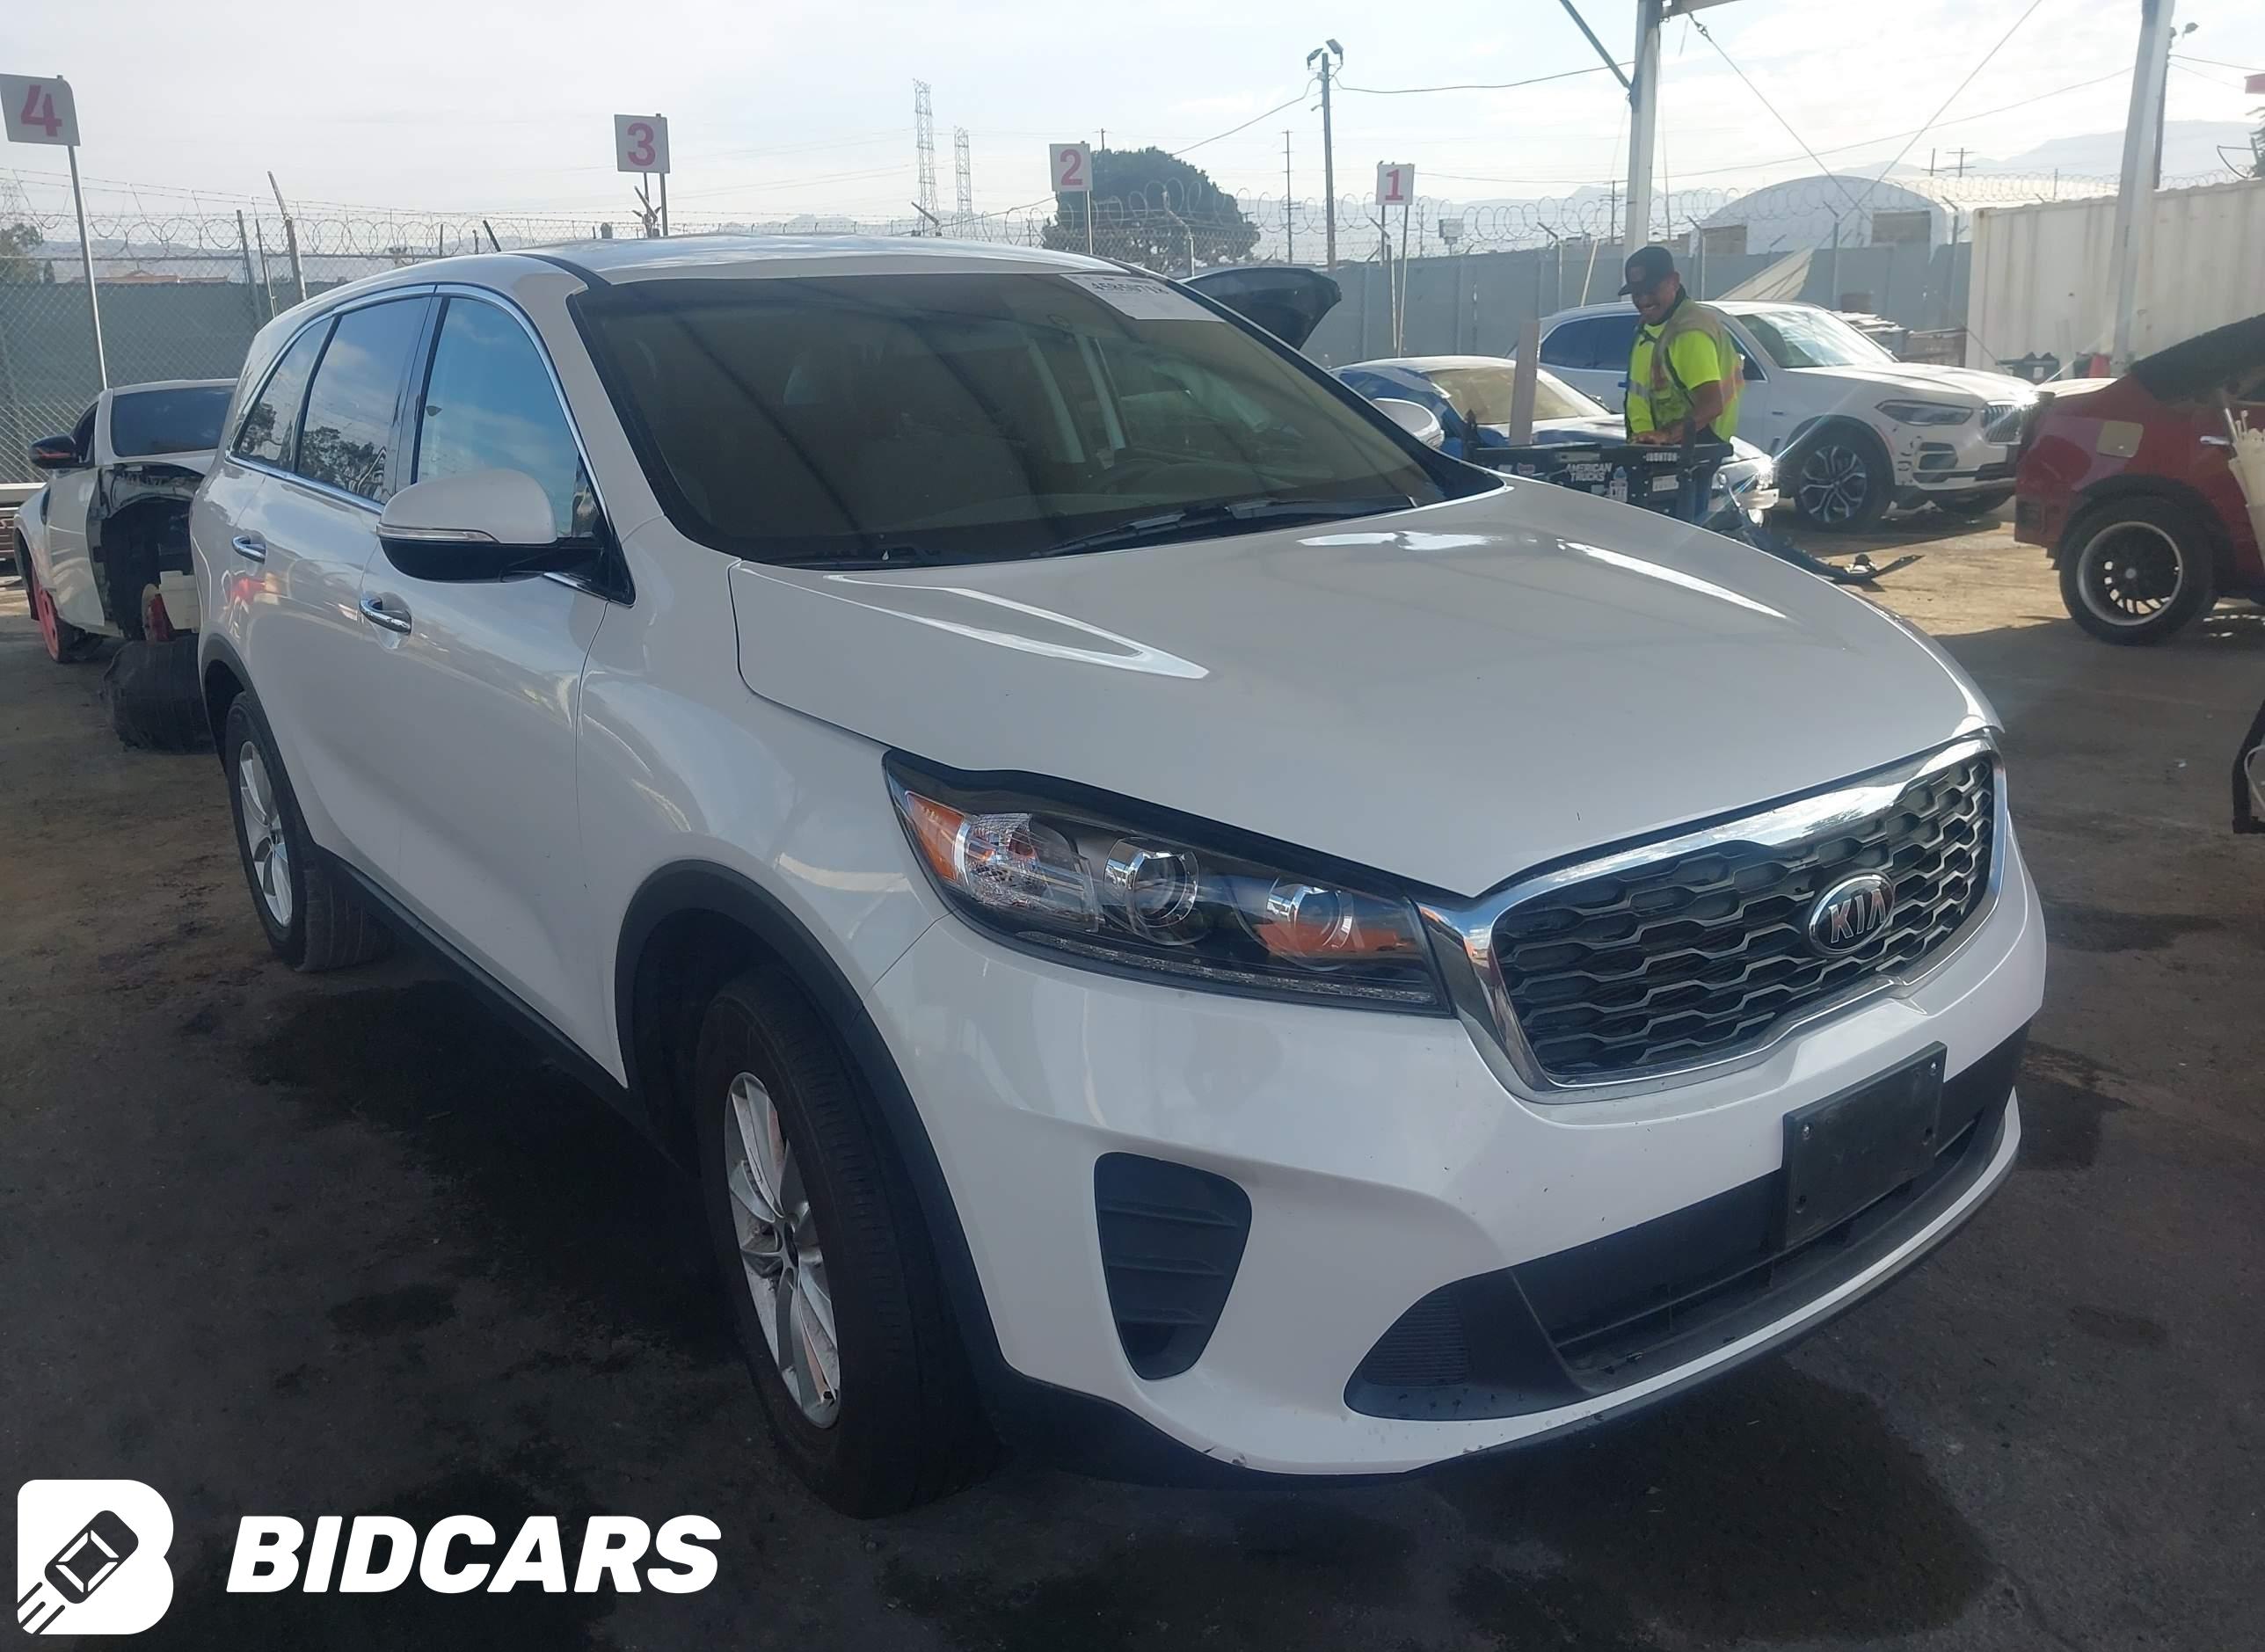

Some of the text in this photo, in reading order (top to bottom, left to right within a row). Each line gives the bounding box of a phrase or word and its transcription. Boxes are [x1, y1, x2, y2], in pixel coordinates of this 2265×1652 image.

[21, 84, 62, 137] 4
[627, 122, 656, 166] 3
[1060, 149, 1083, 186] 2
[1386, 169, 1403, 200] 1
[1565, 462, 1613, 472] AMERICAN
[1569, 472, 1606, 483] TRUCKS
[1828, 888, 1887, 943] KIA
